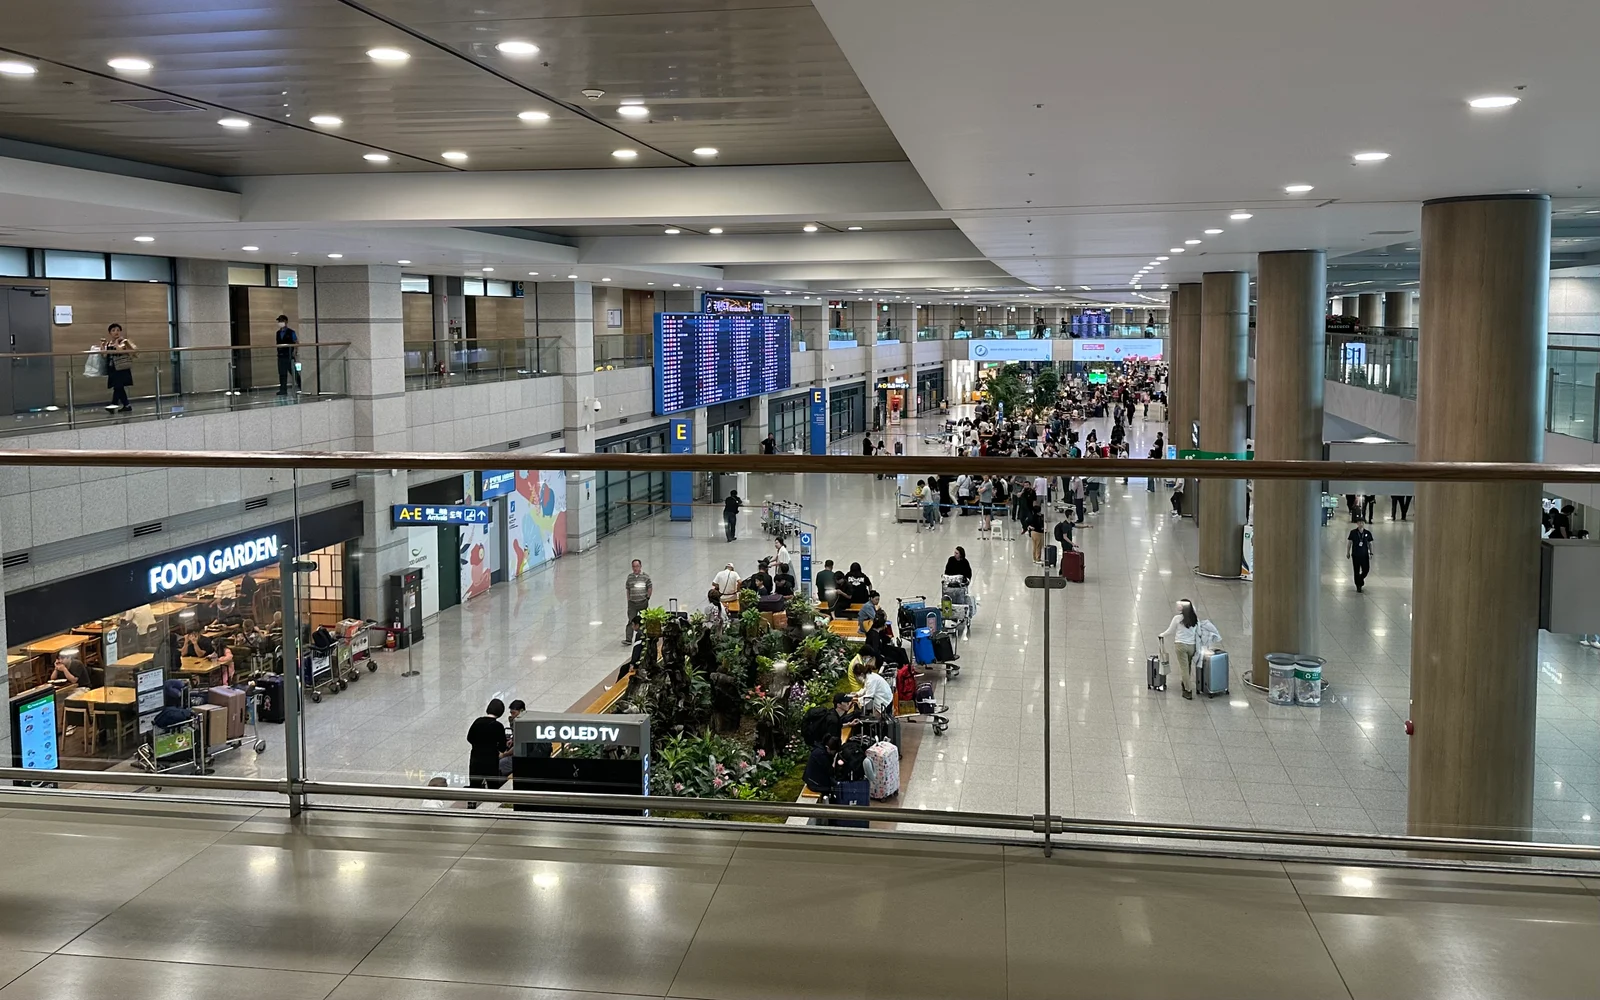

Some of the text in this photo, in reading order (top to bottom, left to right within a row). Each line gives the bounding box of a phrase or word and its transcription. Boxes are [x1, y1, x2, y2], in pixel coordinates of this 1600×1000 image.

[814, 391, 822, 403] E
[676, 424, 687, 440] E
[399, 507, 422, 521] A-E
[149, 534, 279, 594] FOOD GARDEN
[536, 725, 620, 742] LG OLED TV
